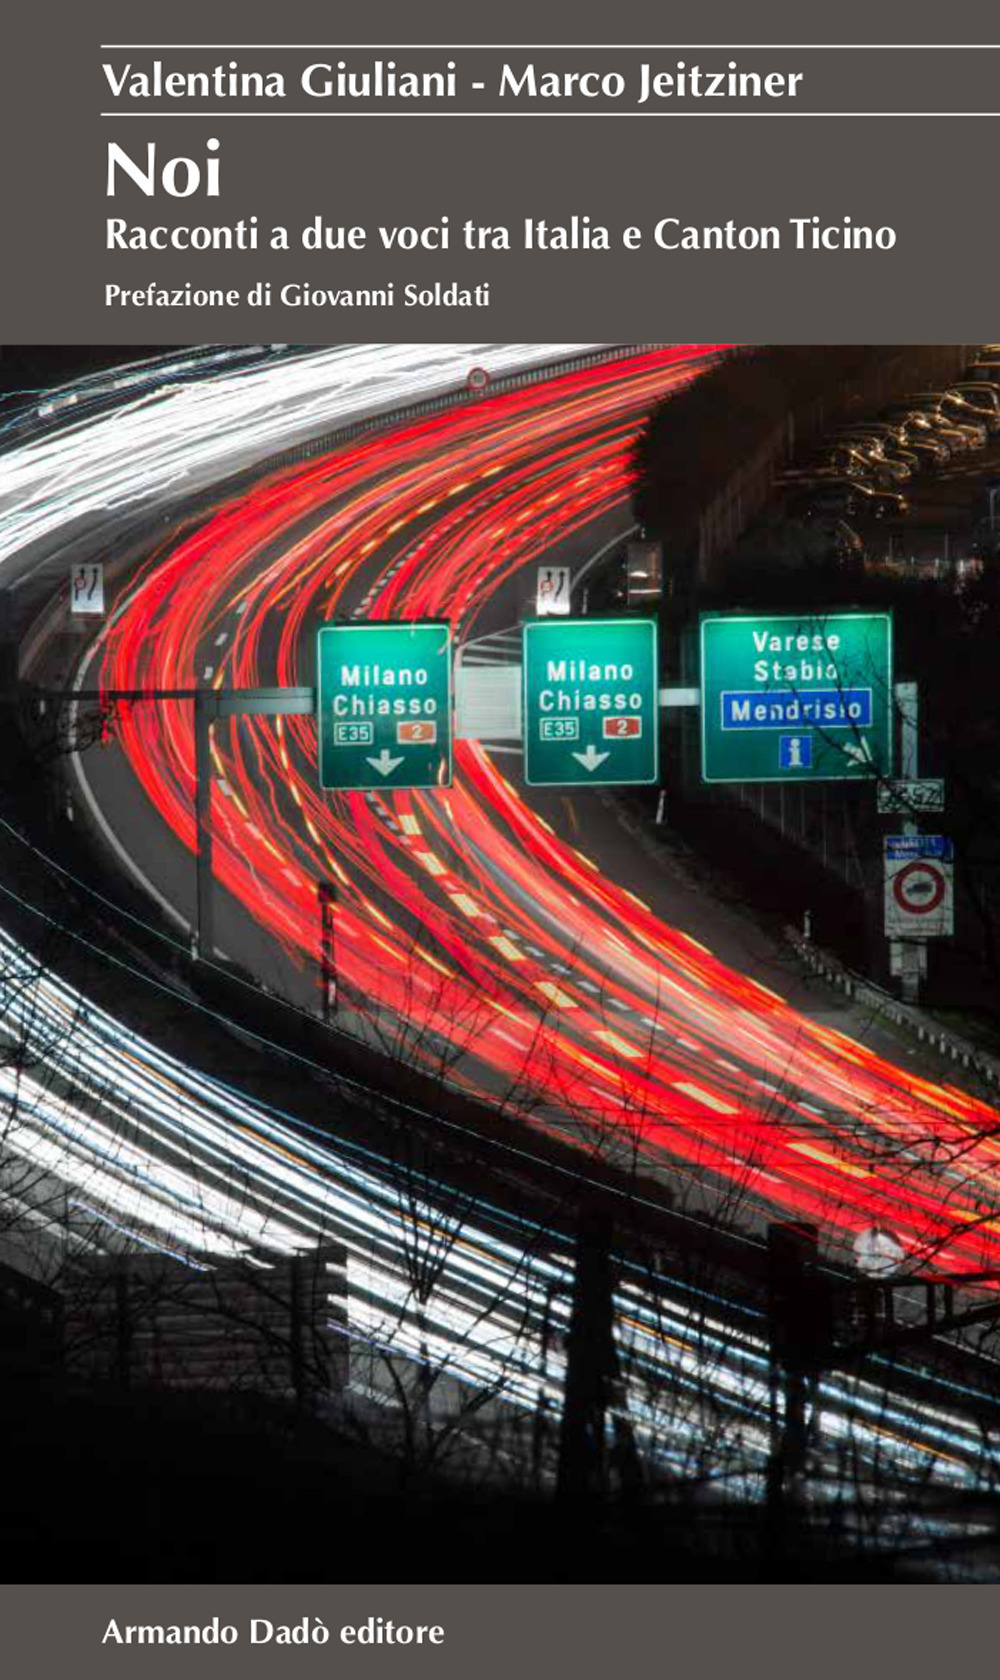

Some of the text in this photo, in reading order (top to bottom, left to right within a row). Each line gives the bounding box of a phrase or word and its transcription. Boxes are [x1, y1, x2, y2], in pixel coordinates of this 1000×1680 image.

[752, 631, 841, 654] Varese
[340, 665, 428, 686] Milano
[547, 661, 633, 682] Milano
[333, 694, 437, 716] Chiasso
[538, 690, 643, 712] Chiasso
[731, 699, 862, 722] Mendrisio
[337, 724, 423, 741] E35 2
[543, 720, 628, 737] E35 2
